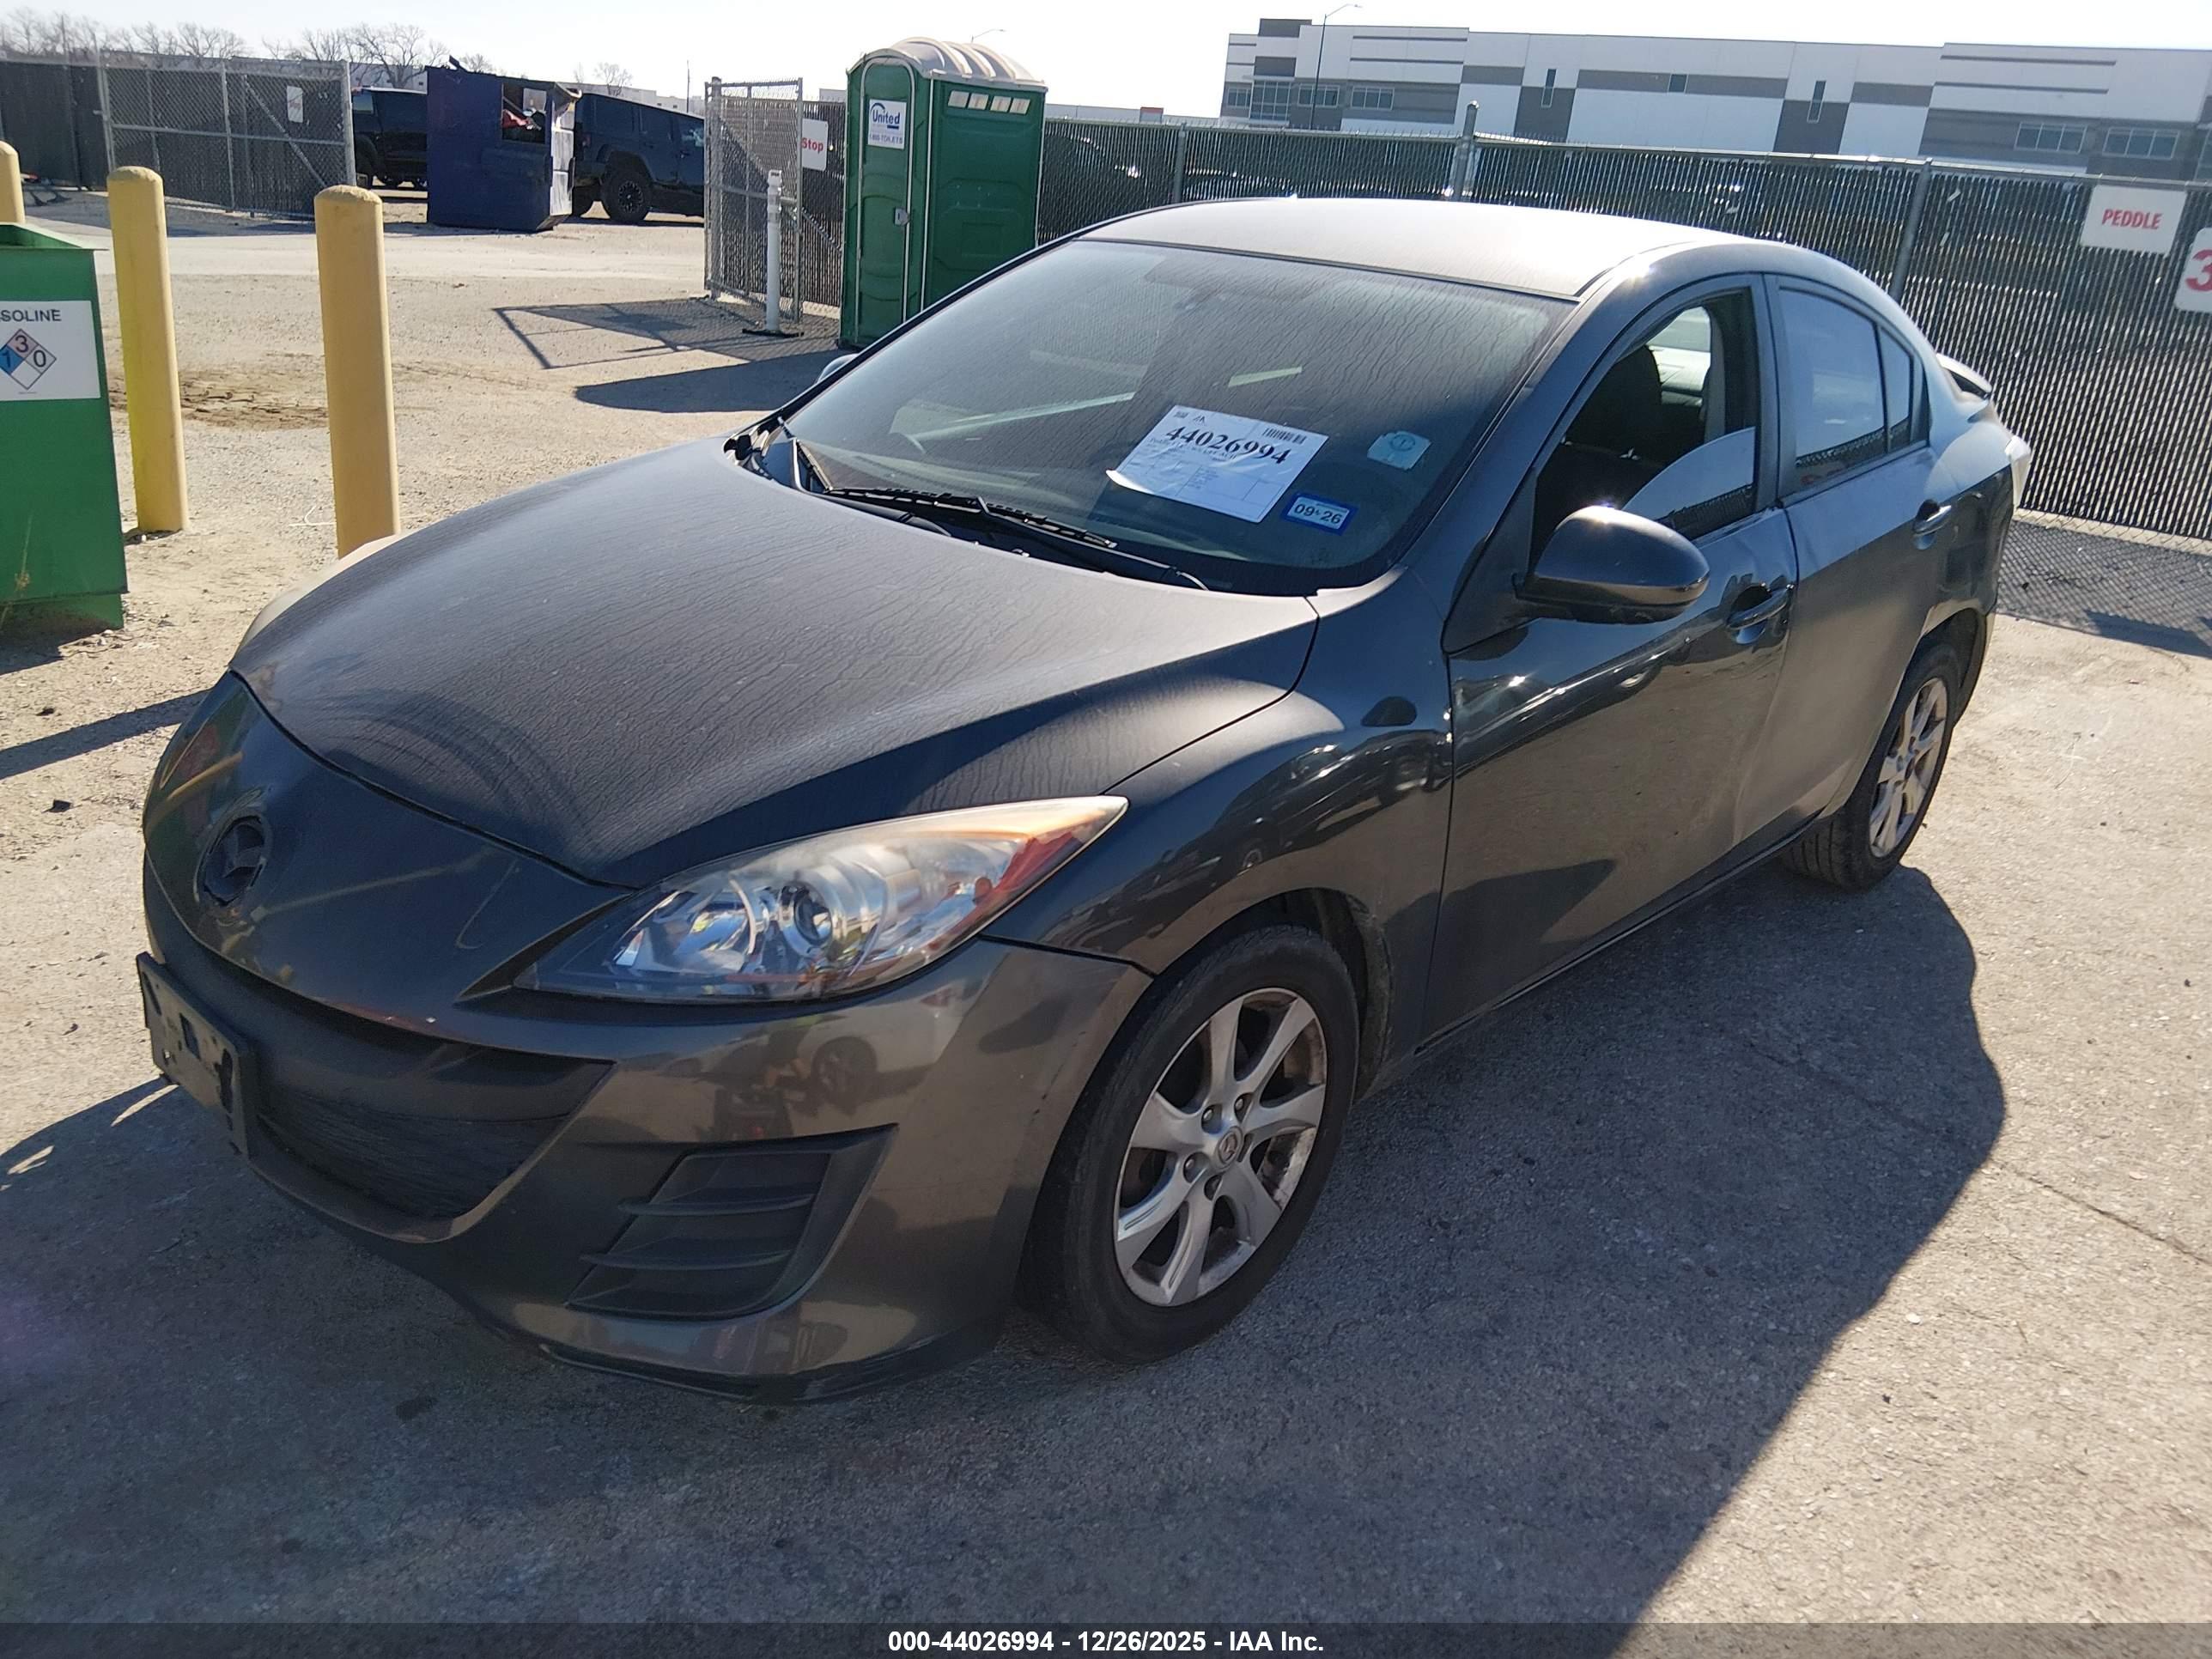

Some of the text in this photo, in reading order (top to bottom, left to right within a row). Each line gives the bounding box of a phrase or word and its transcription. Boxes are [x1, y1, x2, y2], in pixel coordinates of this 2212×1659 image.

[872, 109, 901, 125] United
[801, 137, 823, 154] Stop
[2101, 209, 2162, 230] PEDDLE
[0, 308, 62, 322] SOLINE
[15, 335, 29, 353] 3
[2, 349, 46, 368] 1 0
[1166, 426, 1291, 464] 44026994
[1294, 503, 1316, 517] 09
[1320, 511, 1343, 524] 26
